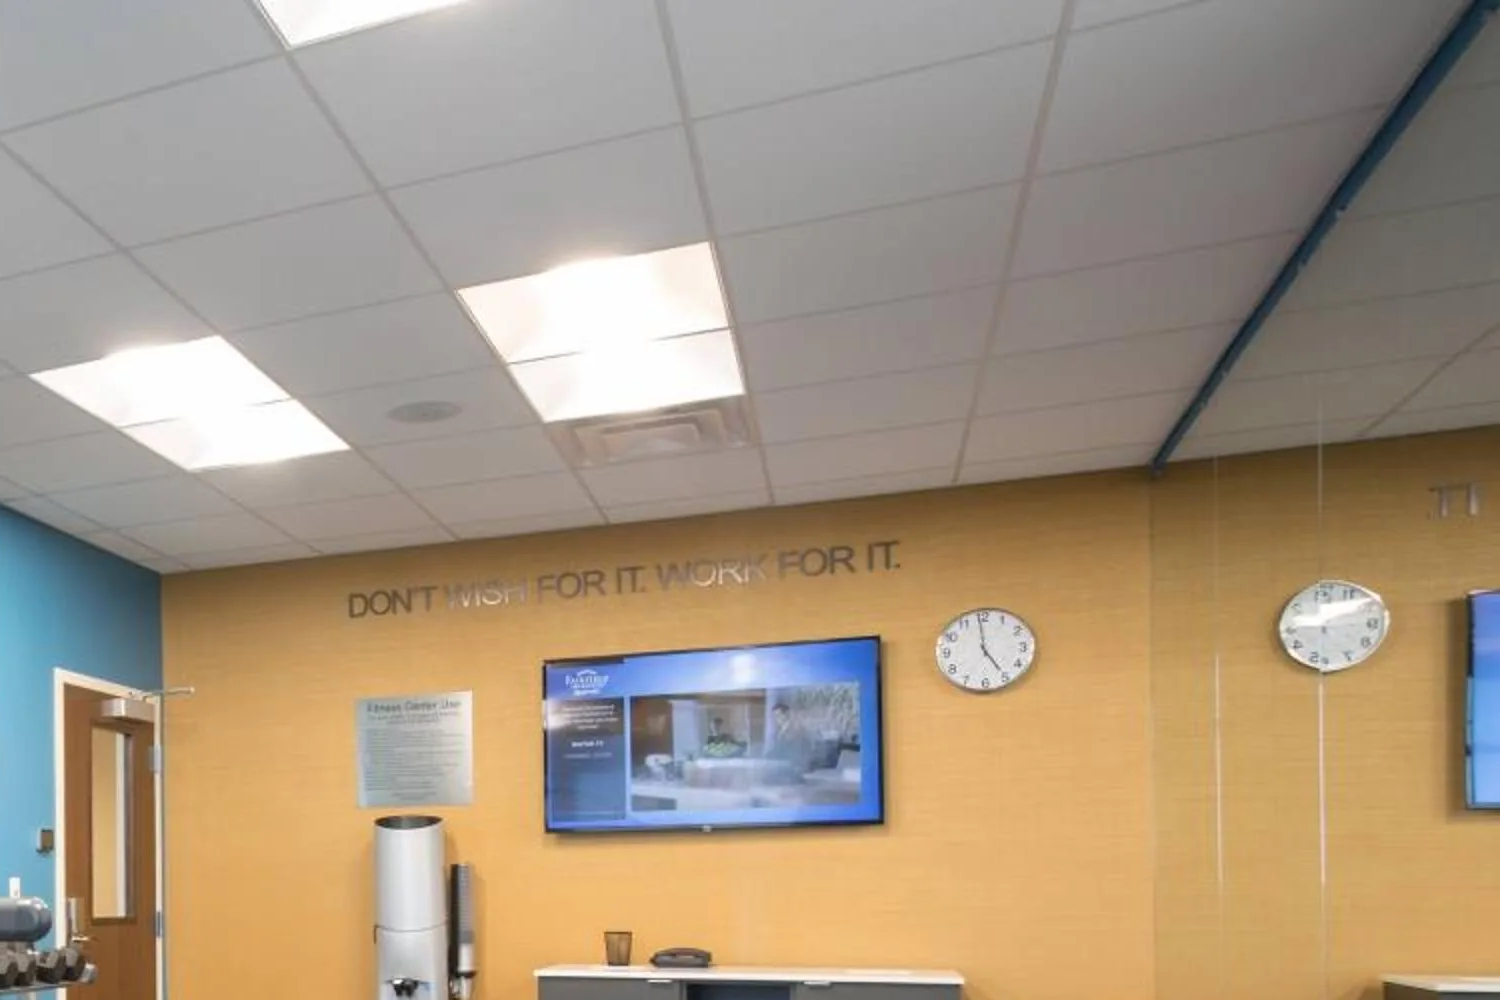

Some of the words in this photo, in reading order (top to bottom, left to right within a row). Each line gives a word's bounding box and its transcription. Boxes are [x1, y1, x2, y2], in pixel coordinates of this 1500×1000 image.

[348, 586, 438, 619] DON'T
[443, 576, 528, 609] WISH
[537, 569, 607, 604] FOR
[616, 565, 647, 594] IT.
[657, 553, 769, 591] WORK
[778, 545, 856, 579] FOR
[868, 540, 901, 572] IT.
[959, 618, 970, 630] 11
[1000, 615, 1006, 625] 1
[1013, 625, 1023, 636] 2
[945, 631, 958, 643] 10
[942, 647, 951, 659] 9
[1019, 641, 1028, 653] 3
[948, 663, 957, 675] 8
[1013, 658, 1023, 668] 4
[963, 674, 970, 685] 7
[981, 677, 990, 689] 6
[1001, 671, 1010, 683] 5
